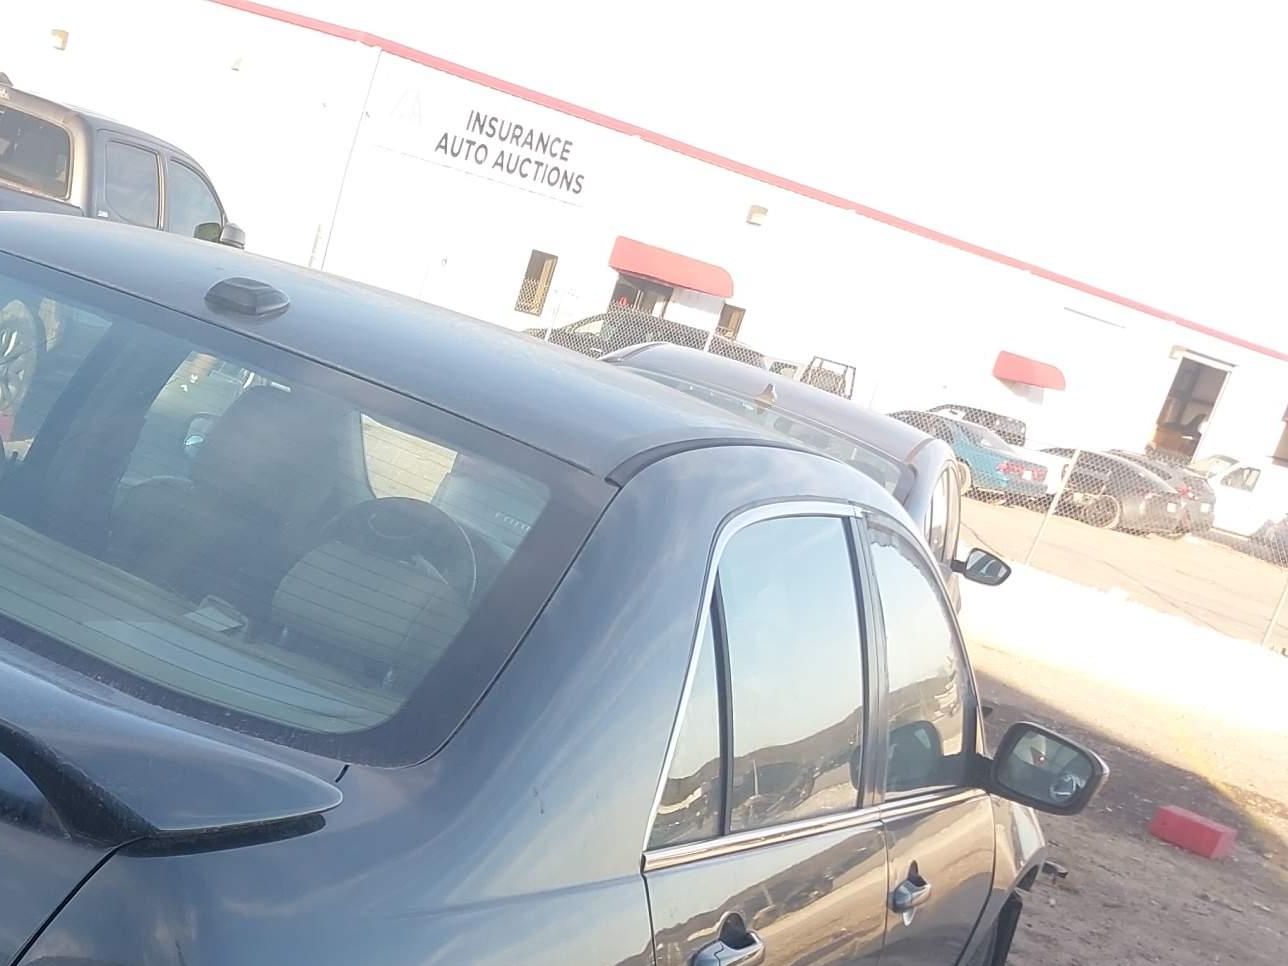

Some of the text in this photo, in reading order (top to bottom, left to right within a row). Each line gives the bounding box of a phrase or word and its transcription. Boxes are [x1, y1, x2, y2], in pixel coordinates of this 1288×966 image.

[434, 132, 585, 194] AUTO AUCTIONS
[466, 109, 573, 162] INSURANCE
